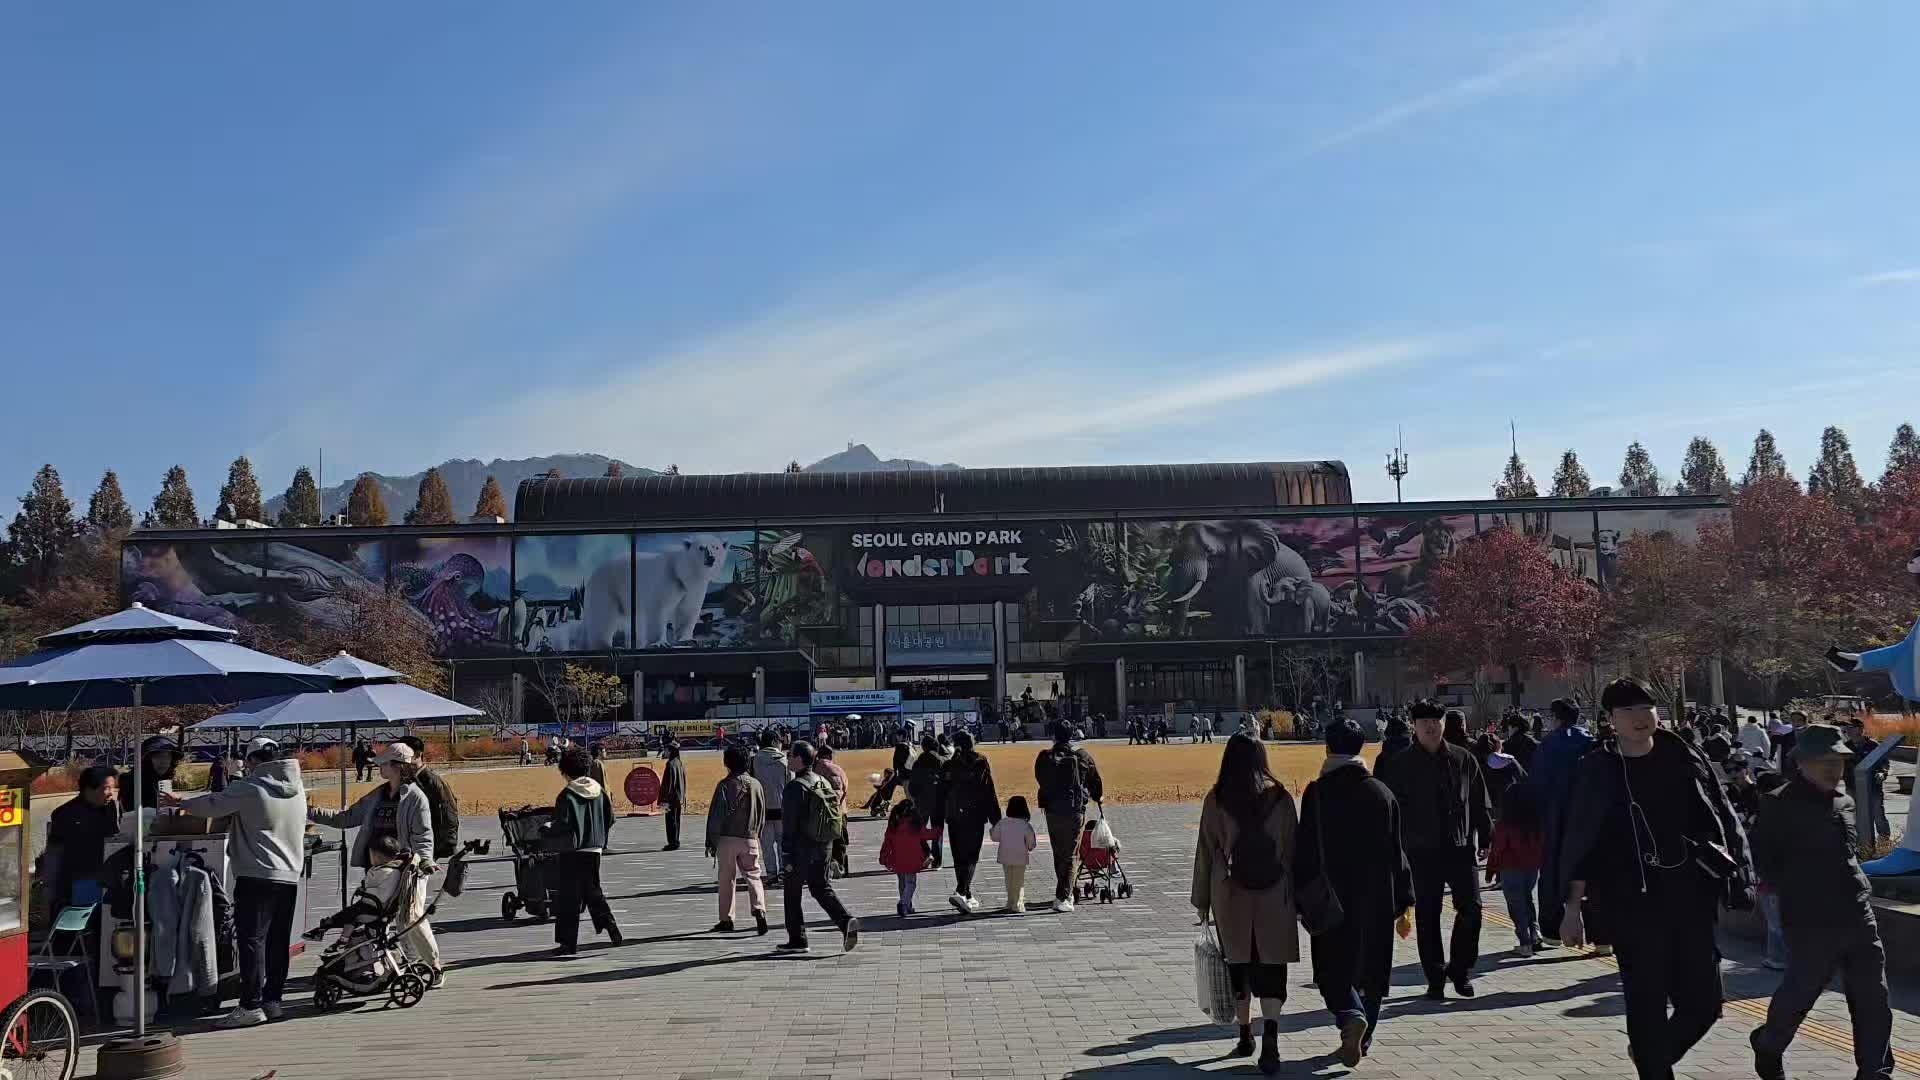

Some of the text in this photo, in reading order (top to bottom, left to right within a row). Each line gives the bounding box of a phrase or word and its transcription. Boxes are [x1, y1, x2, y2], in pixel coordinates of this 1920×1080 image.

[851, 530, 1022, 548] SEOUL GRAND PARK
